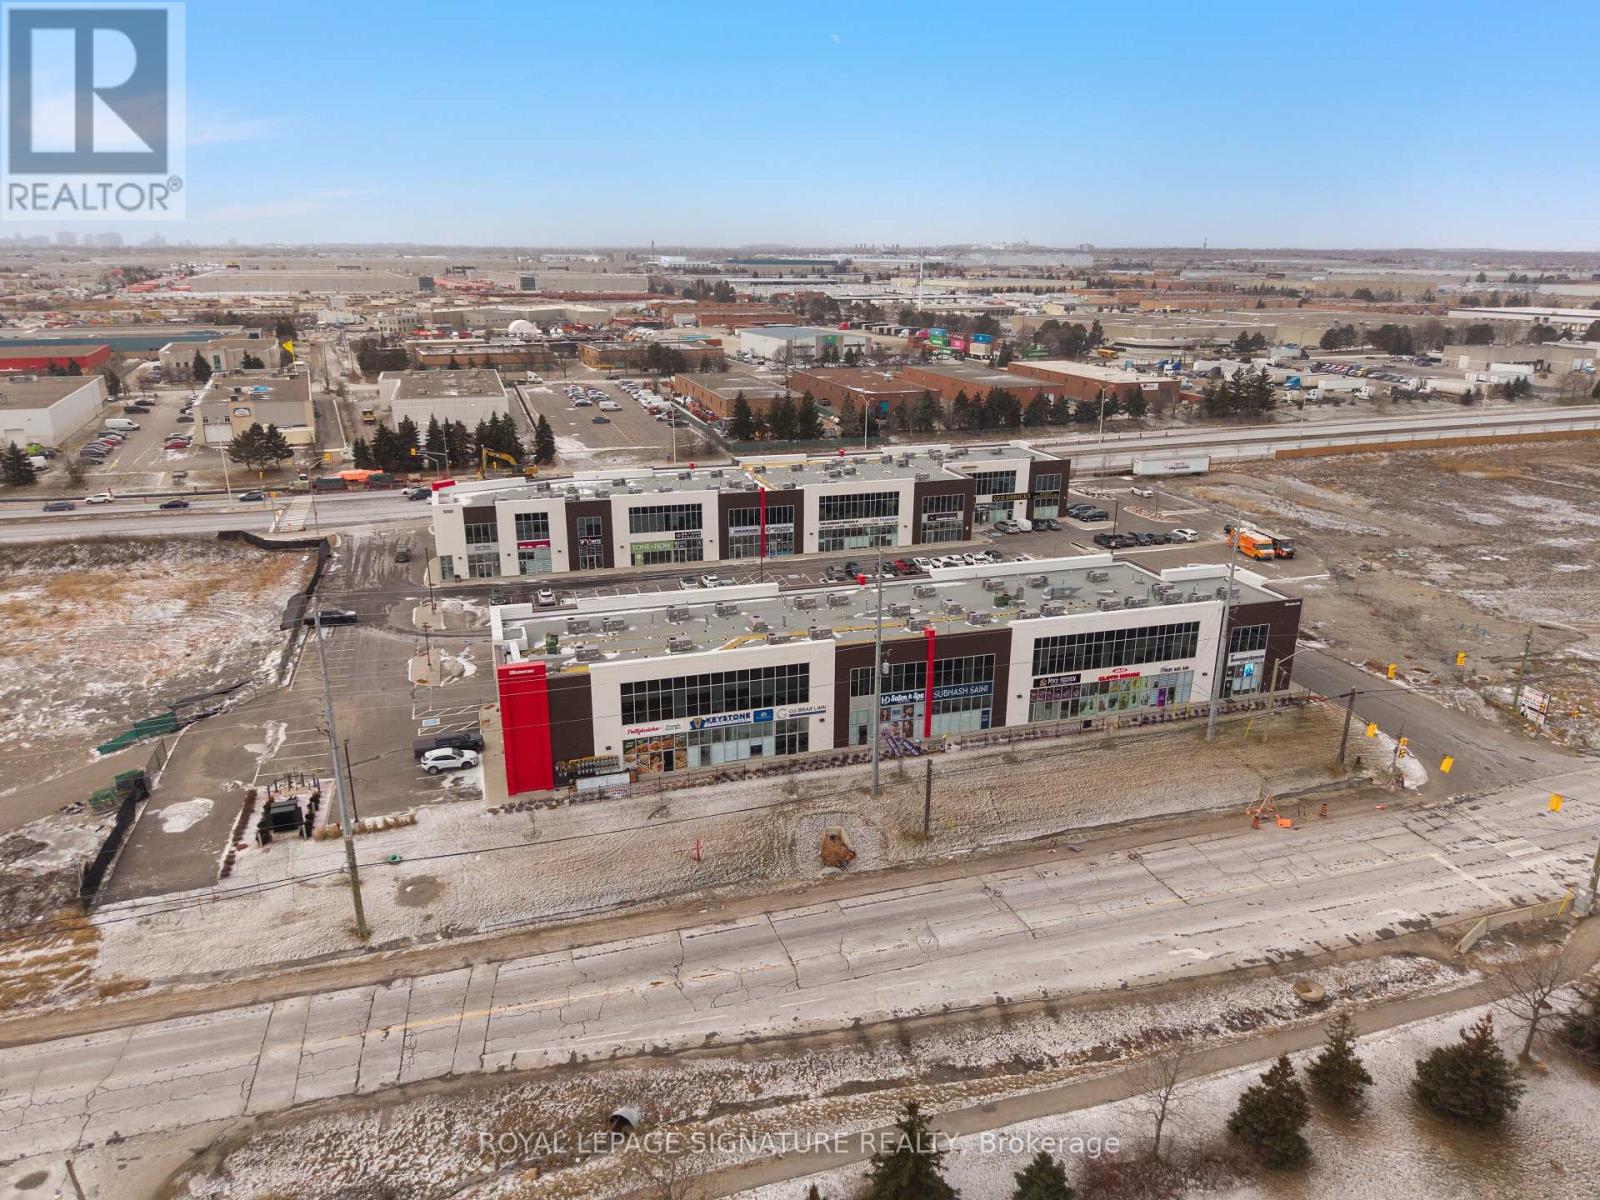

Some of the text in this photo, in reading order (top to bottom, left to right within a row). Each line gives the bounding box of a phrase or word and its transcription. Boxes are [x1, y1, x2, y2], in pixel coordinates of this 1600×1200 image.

[890, 693, 908, 702] Salon
[913, 692, 925, 701] Spa
[933, 684, 989, 699] SUBHASH SAINI
[705, 712, 751, 724] KEYSTONE
